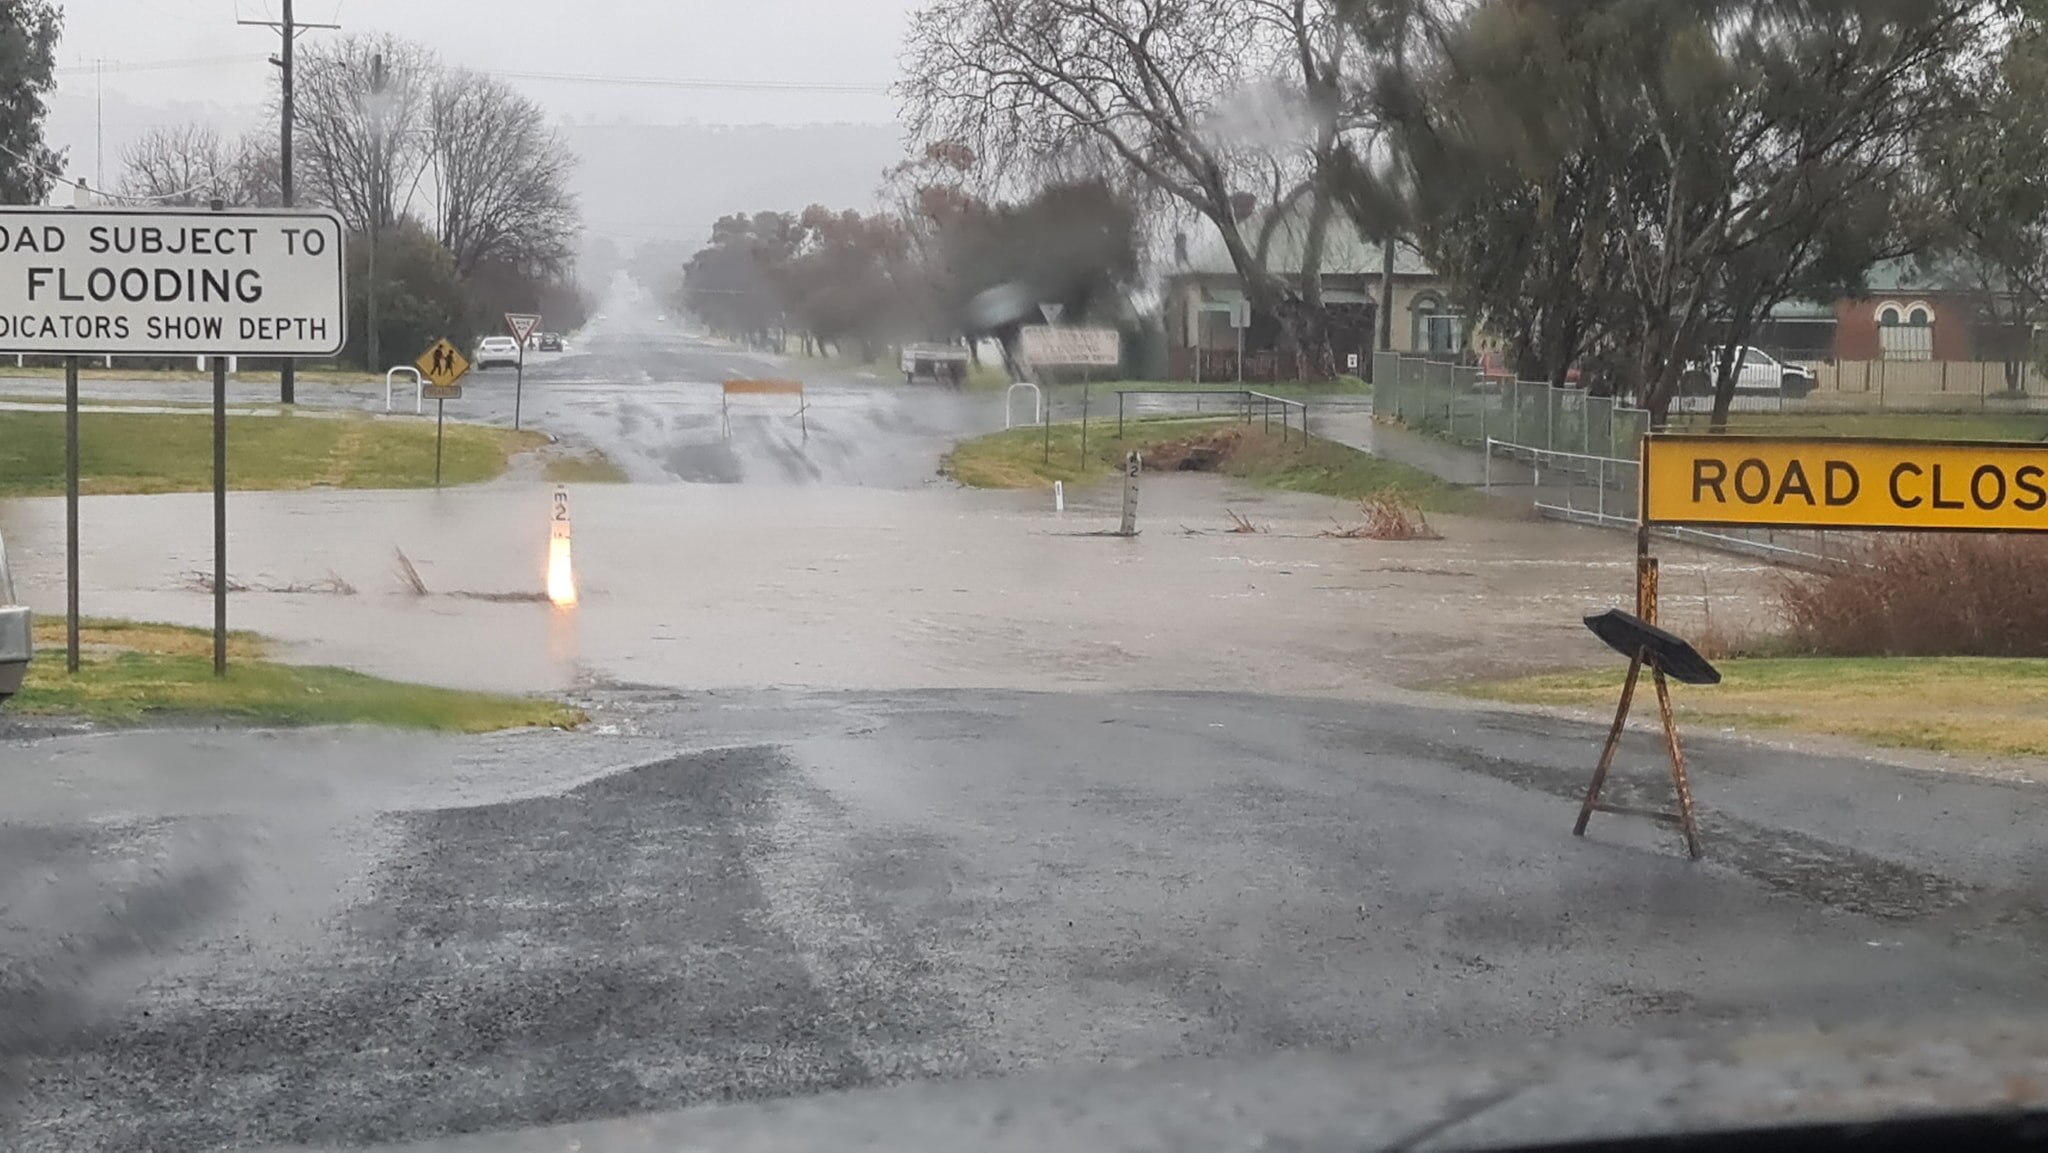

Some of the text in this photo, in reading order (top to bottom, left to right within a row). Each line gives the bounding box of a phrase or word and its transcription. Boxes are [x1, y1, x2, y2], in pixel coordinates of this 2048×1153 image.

[89, 226, 258, 255] SUBJECT
[281, 228, 326, 256] TO
[28, 267, 263, 303] FLOODING
[147, 316, 223, 340] SHOW
[240, 317, 326, 340] DEPTH
[1691, 457, 2048, 512] ROAD CLOS
